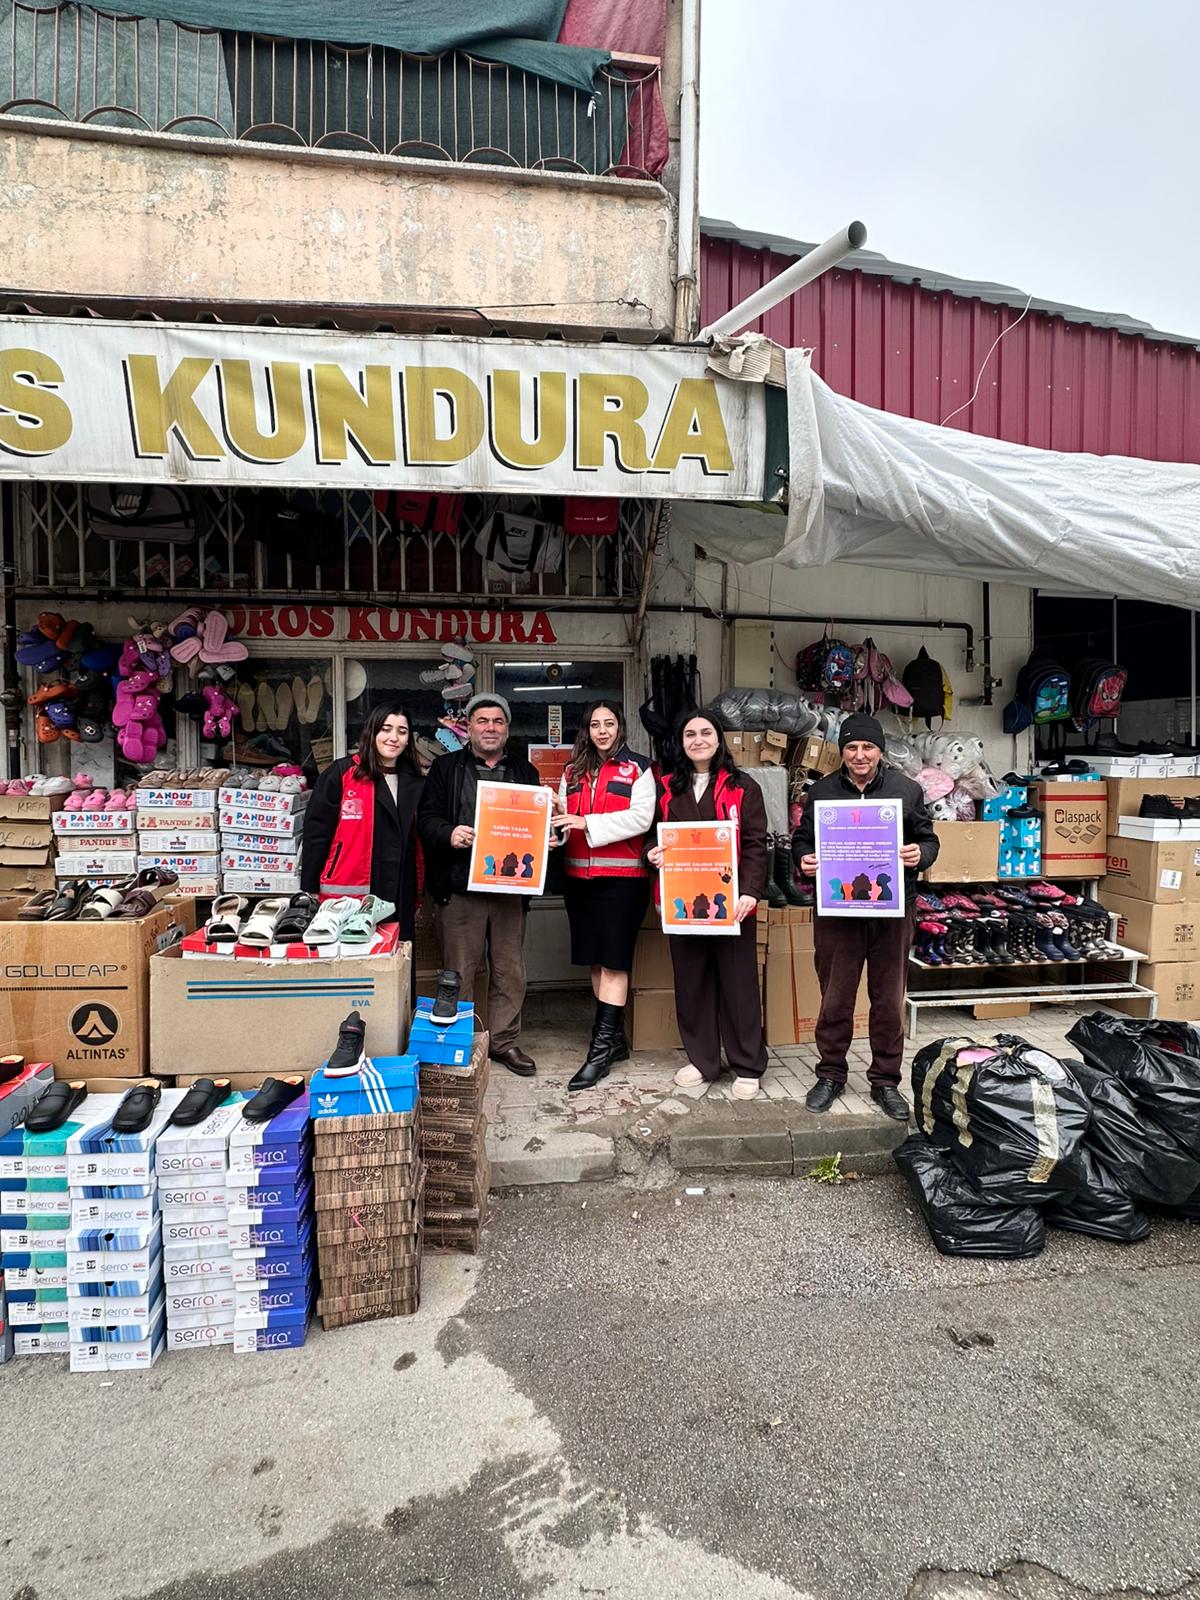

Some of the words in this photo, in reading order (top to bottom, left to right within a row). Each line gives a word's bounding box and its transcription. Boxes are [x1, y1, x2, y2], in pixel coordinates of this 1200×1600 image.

[122, 354, 735, 475] KUNDURA
[347, 608, 557, 643] KUNDURA
[149, 792, 193, 800] PANDUF
[236, 791, 278, 802] PANDUF
[70, 814, 114, 822] PANDUF
[237, 812, 278, 823] PANDUF
[1055, 809, 1102, 826] Claspack
[79, 839, 118, 847] PANDUF
[237, 834, 279, 845] PANDUF
[154, 858, 198, 866] PANDUF
[239, 855, 280, 864] PANDUF
[352, 999, 371, 1007] EVA
[244, 1150, 286, 1163] serra
[162, 1157, 204, 1170] serra
[165, 1191, 206, 1204] serra
[239, 1190, 281, 1203] serra
[169, 1225, 212, 1239] serra
[240, 1229, 282, 1242] serra
[170, 1262, 213, 1276] serra
[247, 1262, 289, 1275] serra
[173, 1295, 215, 1309] serra
[250, 1293, 292, 1307] serra
[175, 1327, 217, 1343] serra
[247, 1332, 290, 1346] serra
